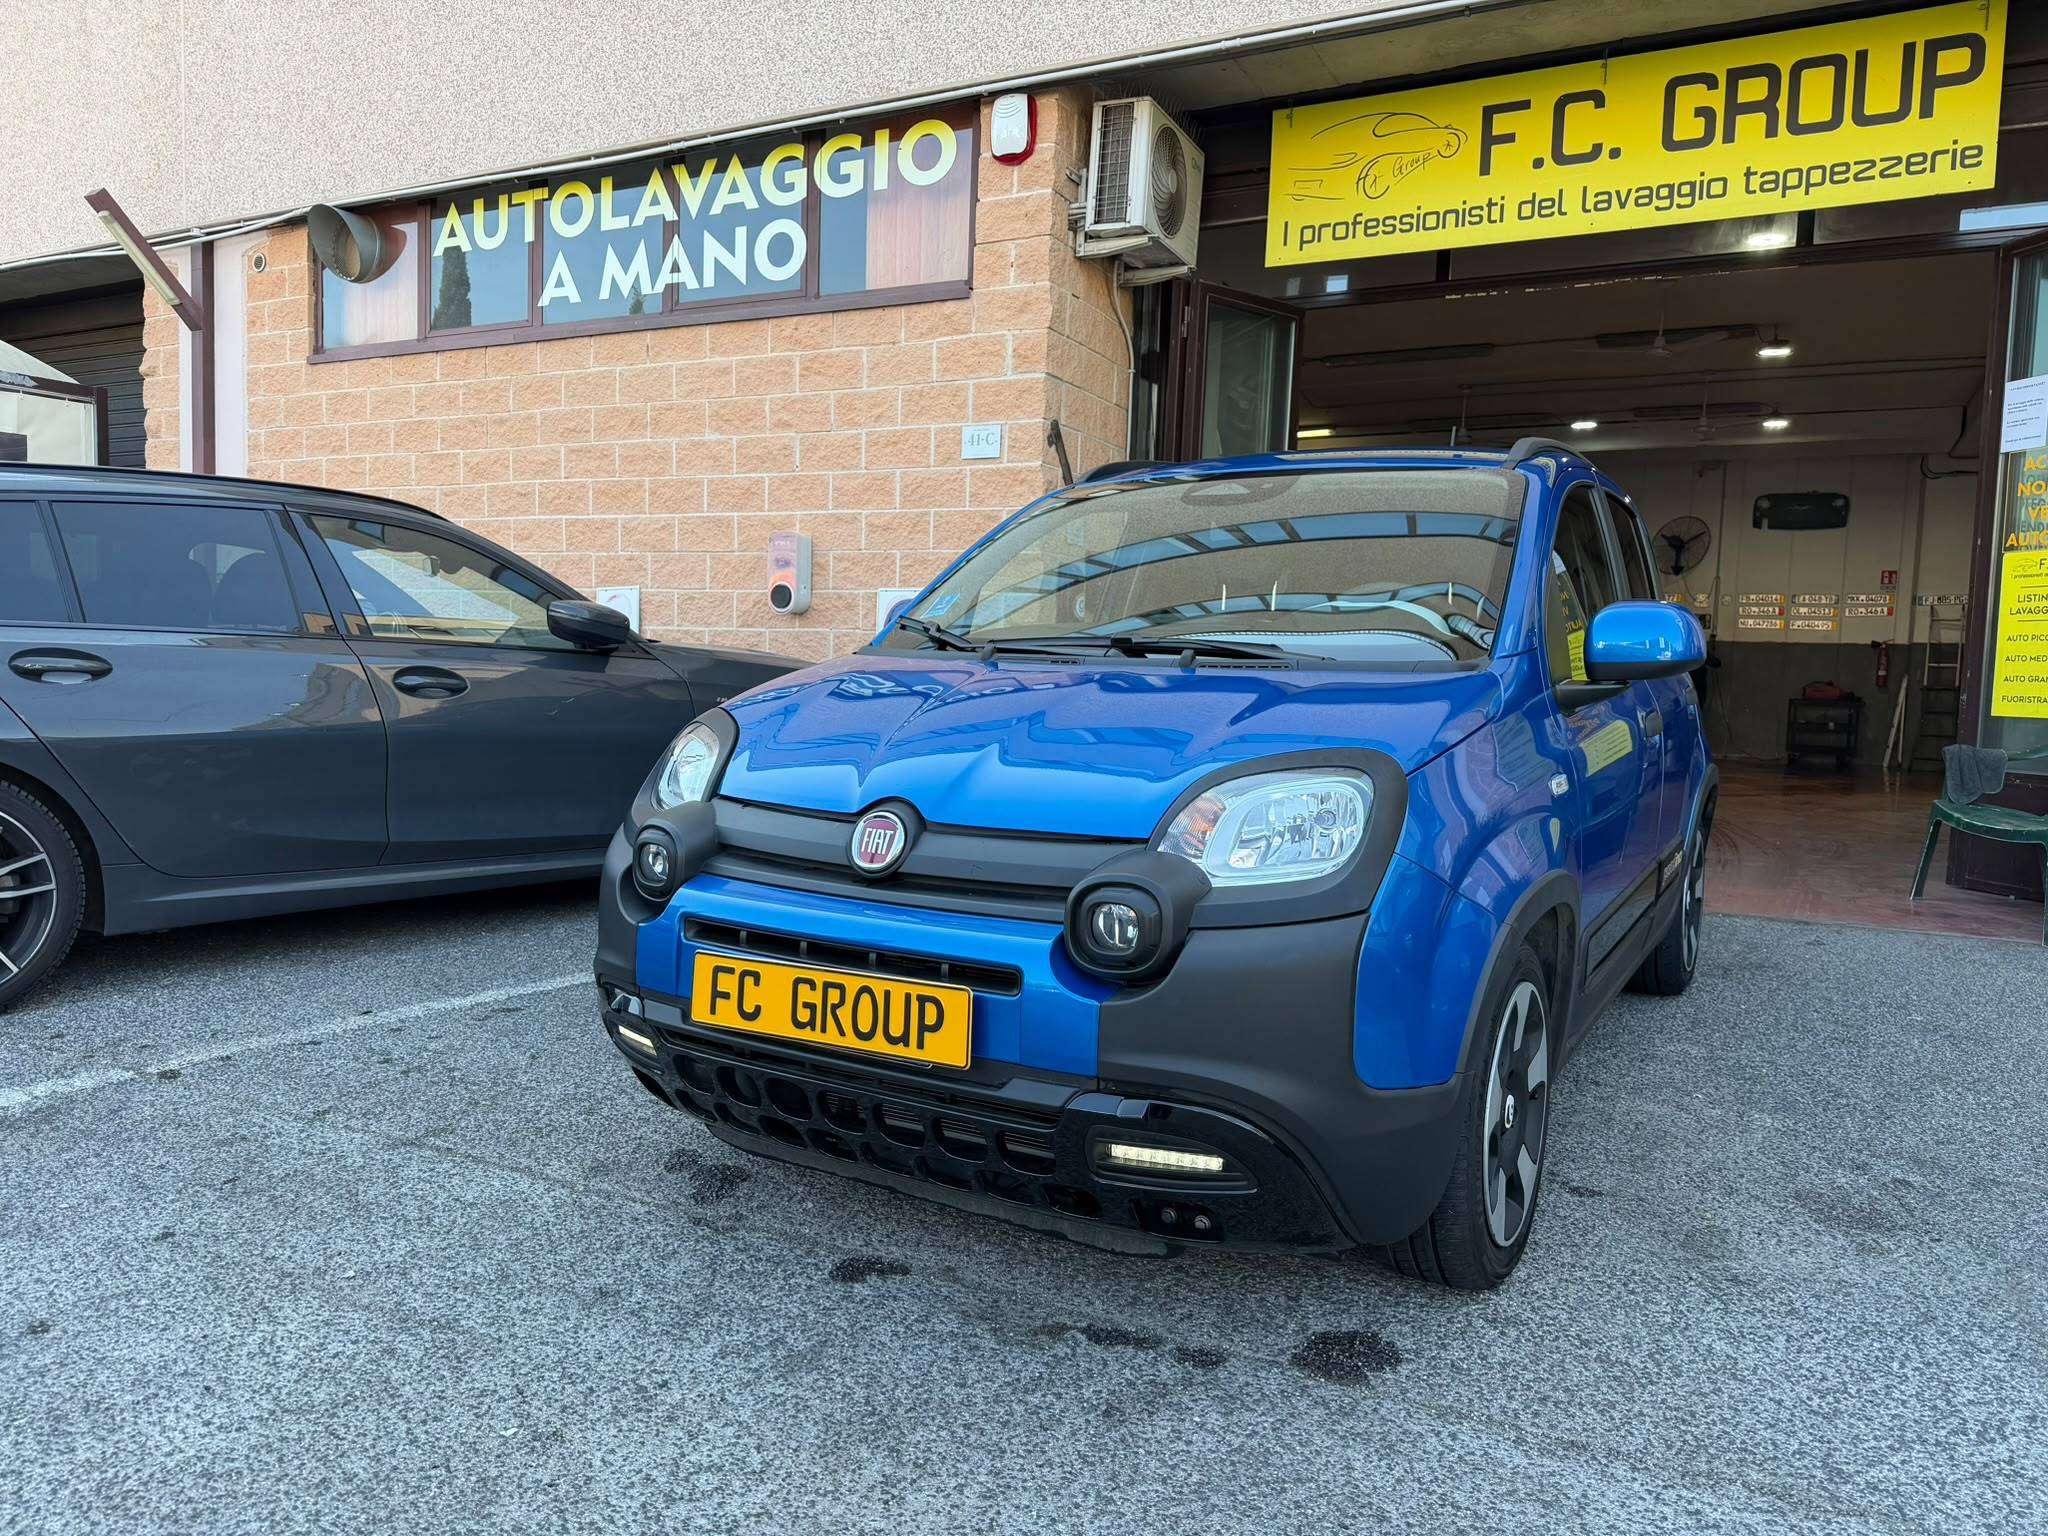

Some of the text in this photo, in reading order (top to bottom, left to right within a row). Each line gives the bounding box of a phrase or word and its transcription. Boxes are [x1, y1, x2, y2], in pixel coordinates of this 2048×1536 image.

[1479, 32, 1987, 176] F.C. GROUP
[433, 119, 957, 257] AUTOLAVAGGIO
[1299, 196, 1505, 252] professionisti
[1517, 186, 1567, 221] del
[1581, 171, 1728, 213] lavaggio
[1743, 139, 1984, 198] tappezzerie
[538, 219, 807, 307] A MANO
[2003, 675, 2026, 683] AUTO
[2005, 654, 2028, 663] AUTO
[2006, 634, 2029, 642] AUTO
[860, 826, 895, 855] FIAT
[709, 964, 945, 1050] FC GROUP
